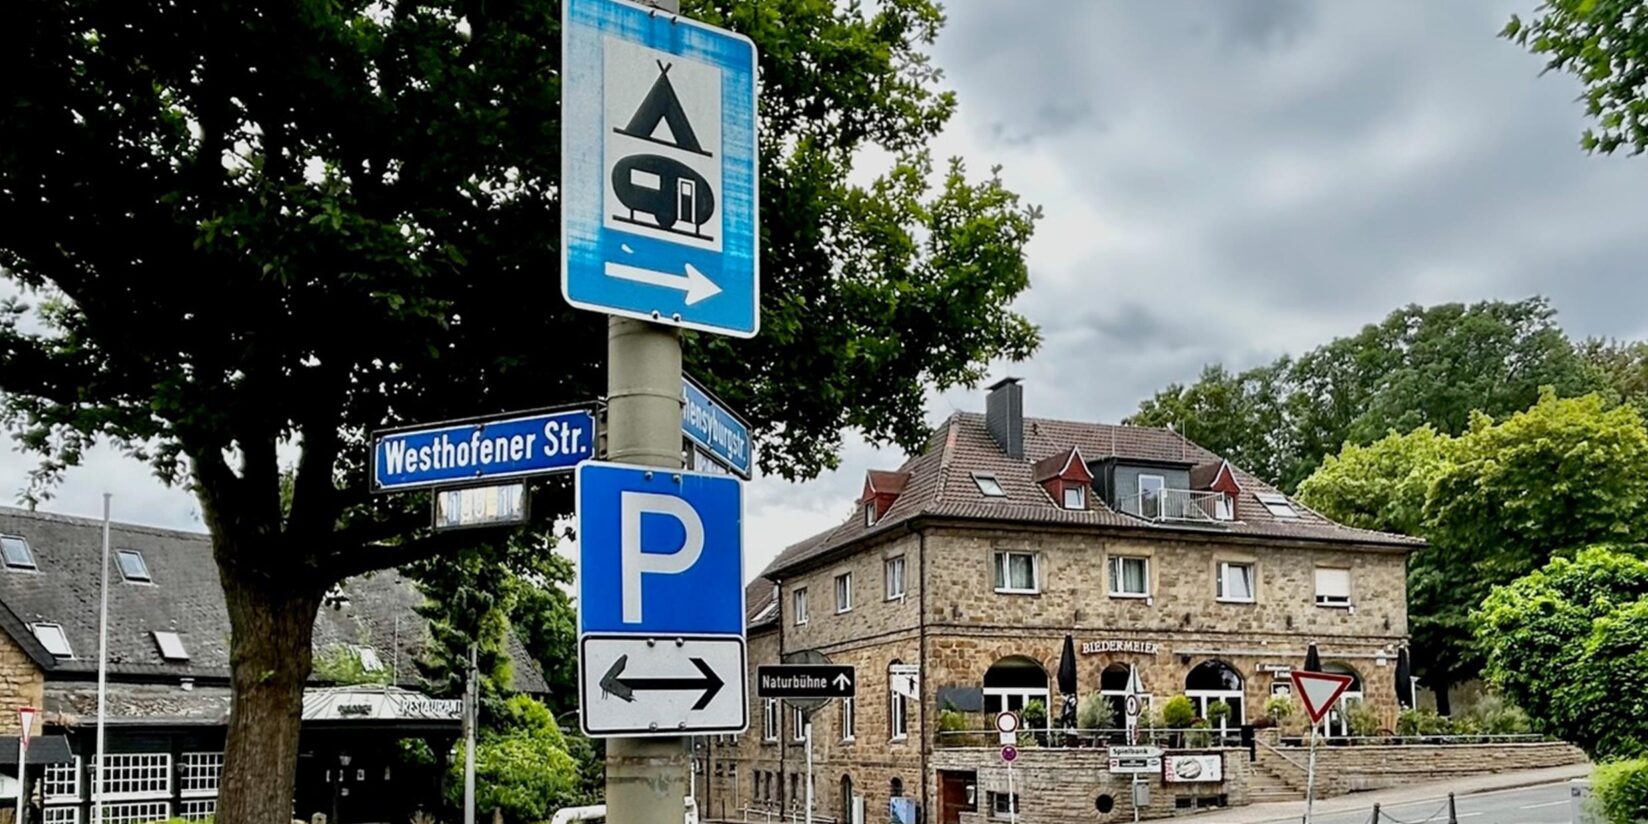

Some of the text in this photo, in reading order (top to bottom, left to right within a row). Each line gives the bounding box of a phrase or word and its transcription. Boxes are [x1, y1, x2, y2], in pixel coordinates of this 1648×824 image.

[682, 386, 746, 462] hensyburgstr.
[385, 420, 587, 475] Westhofener Str.
[621, 491, 705, 623] P
[1082, 640, 1159, 655] BIEDERMEIER
[762, 674, 828, 689] Naturbühne
[402, 699, 462, 713] RESTAURANT
